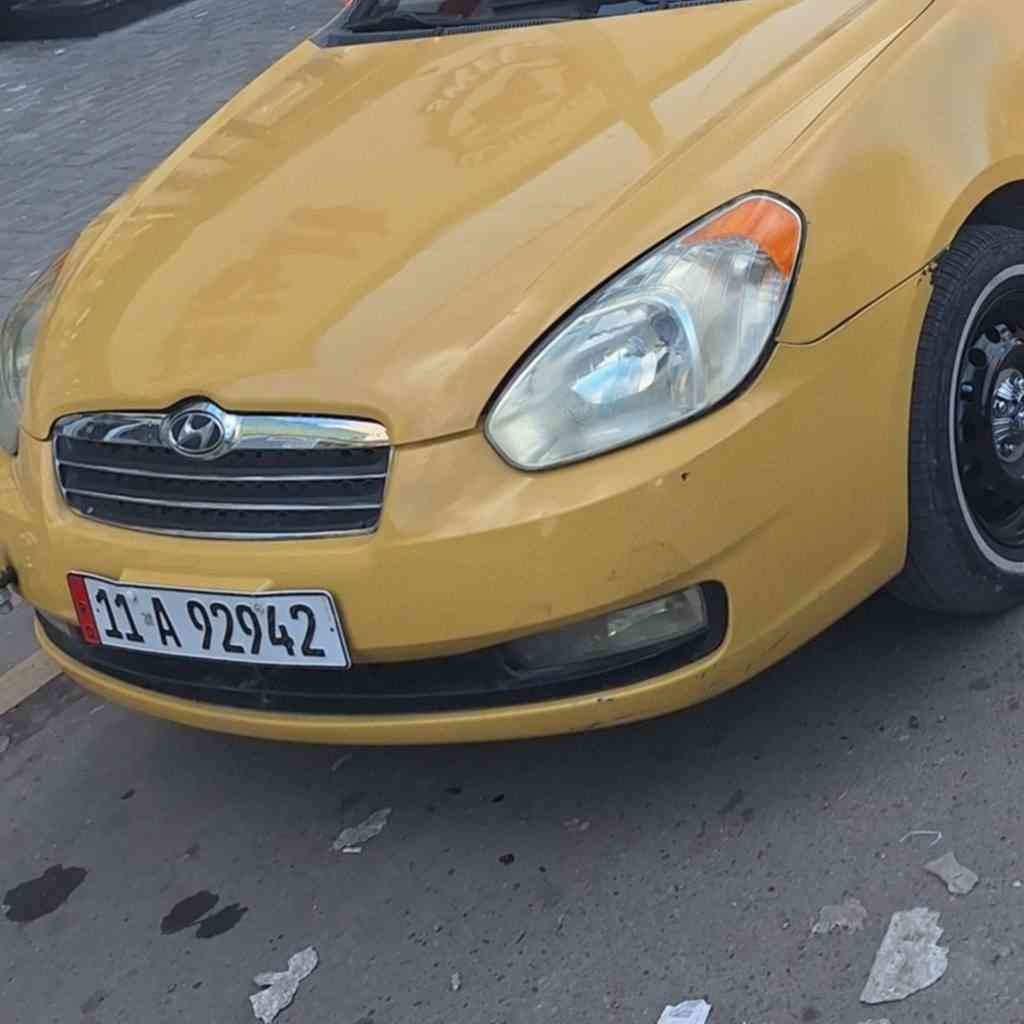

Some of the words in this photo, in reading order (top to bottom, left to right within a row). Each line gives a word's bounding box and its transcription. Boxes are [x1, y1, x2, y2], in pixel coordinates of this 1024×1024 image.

[96, 588, 144, 643] 11
[151, 597, 182, 648] A
[187, 600, 326, 658] 92942
